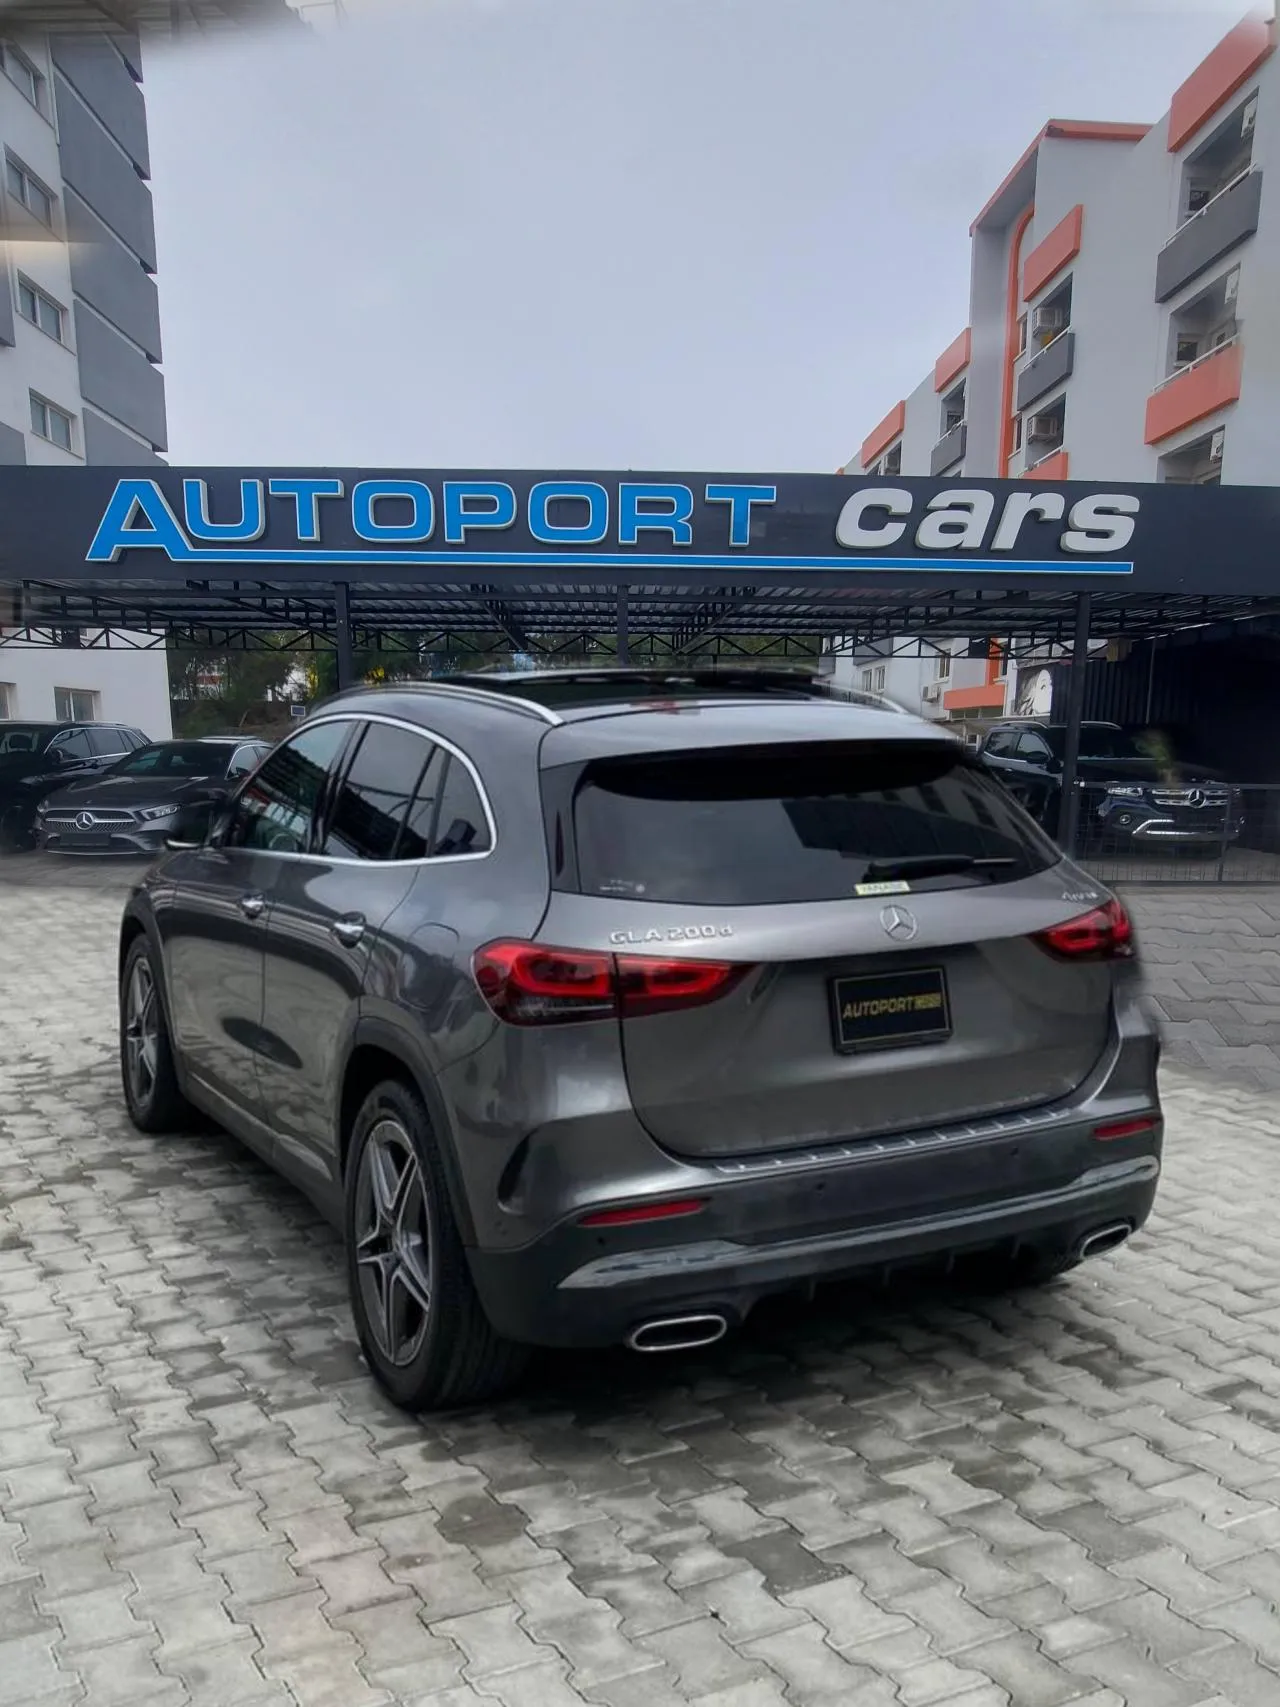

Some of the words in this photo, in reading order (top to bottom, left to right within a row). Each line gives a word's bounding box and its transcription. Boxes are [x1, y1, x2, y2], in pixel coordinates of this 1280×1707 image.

[85, 478, 777, 562] AUTOPORT
[836, 487, 1140, 553] cars
[610, 928, 662, 944] GLA
[843, 997, 914, 1018] AUTOPORT
